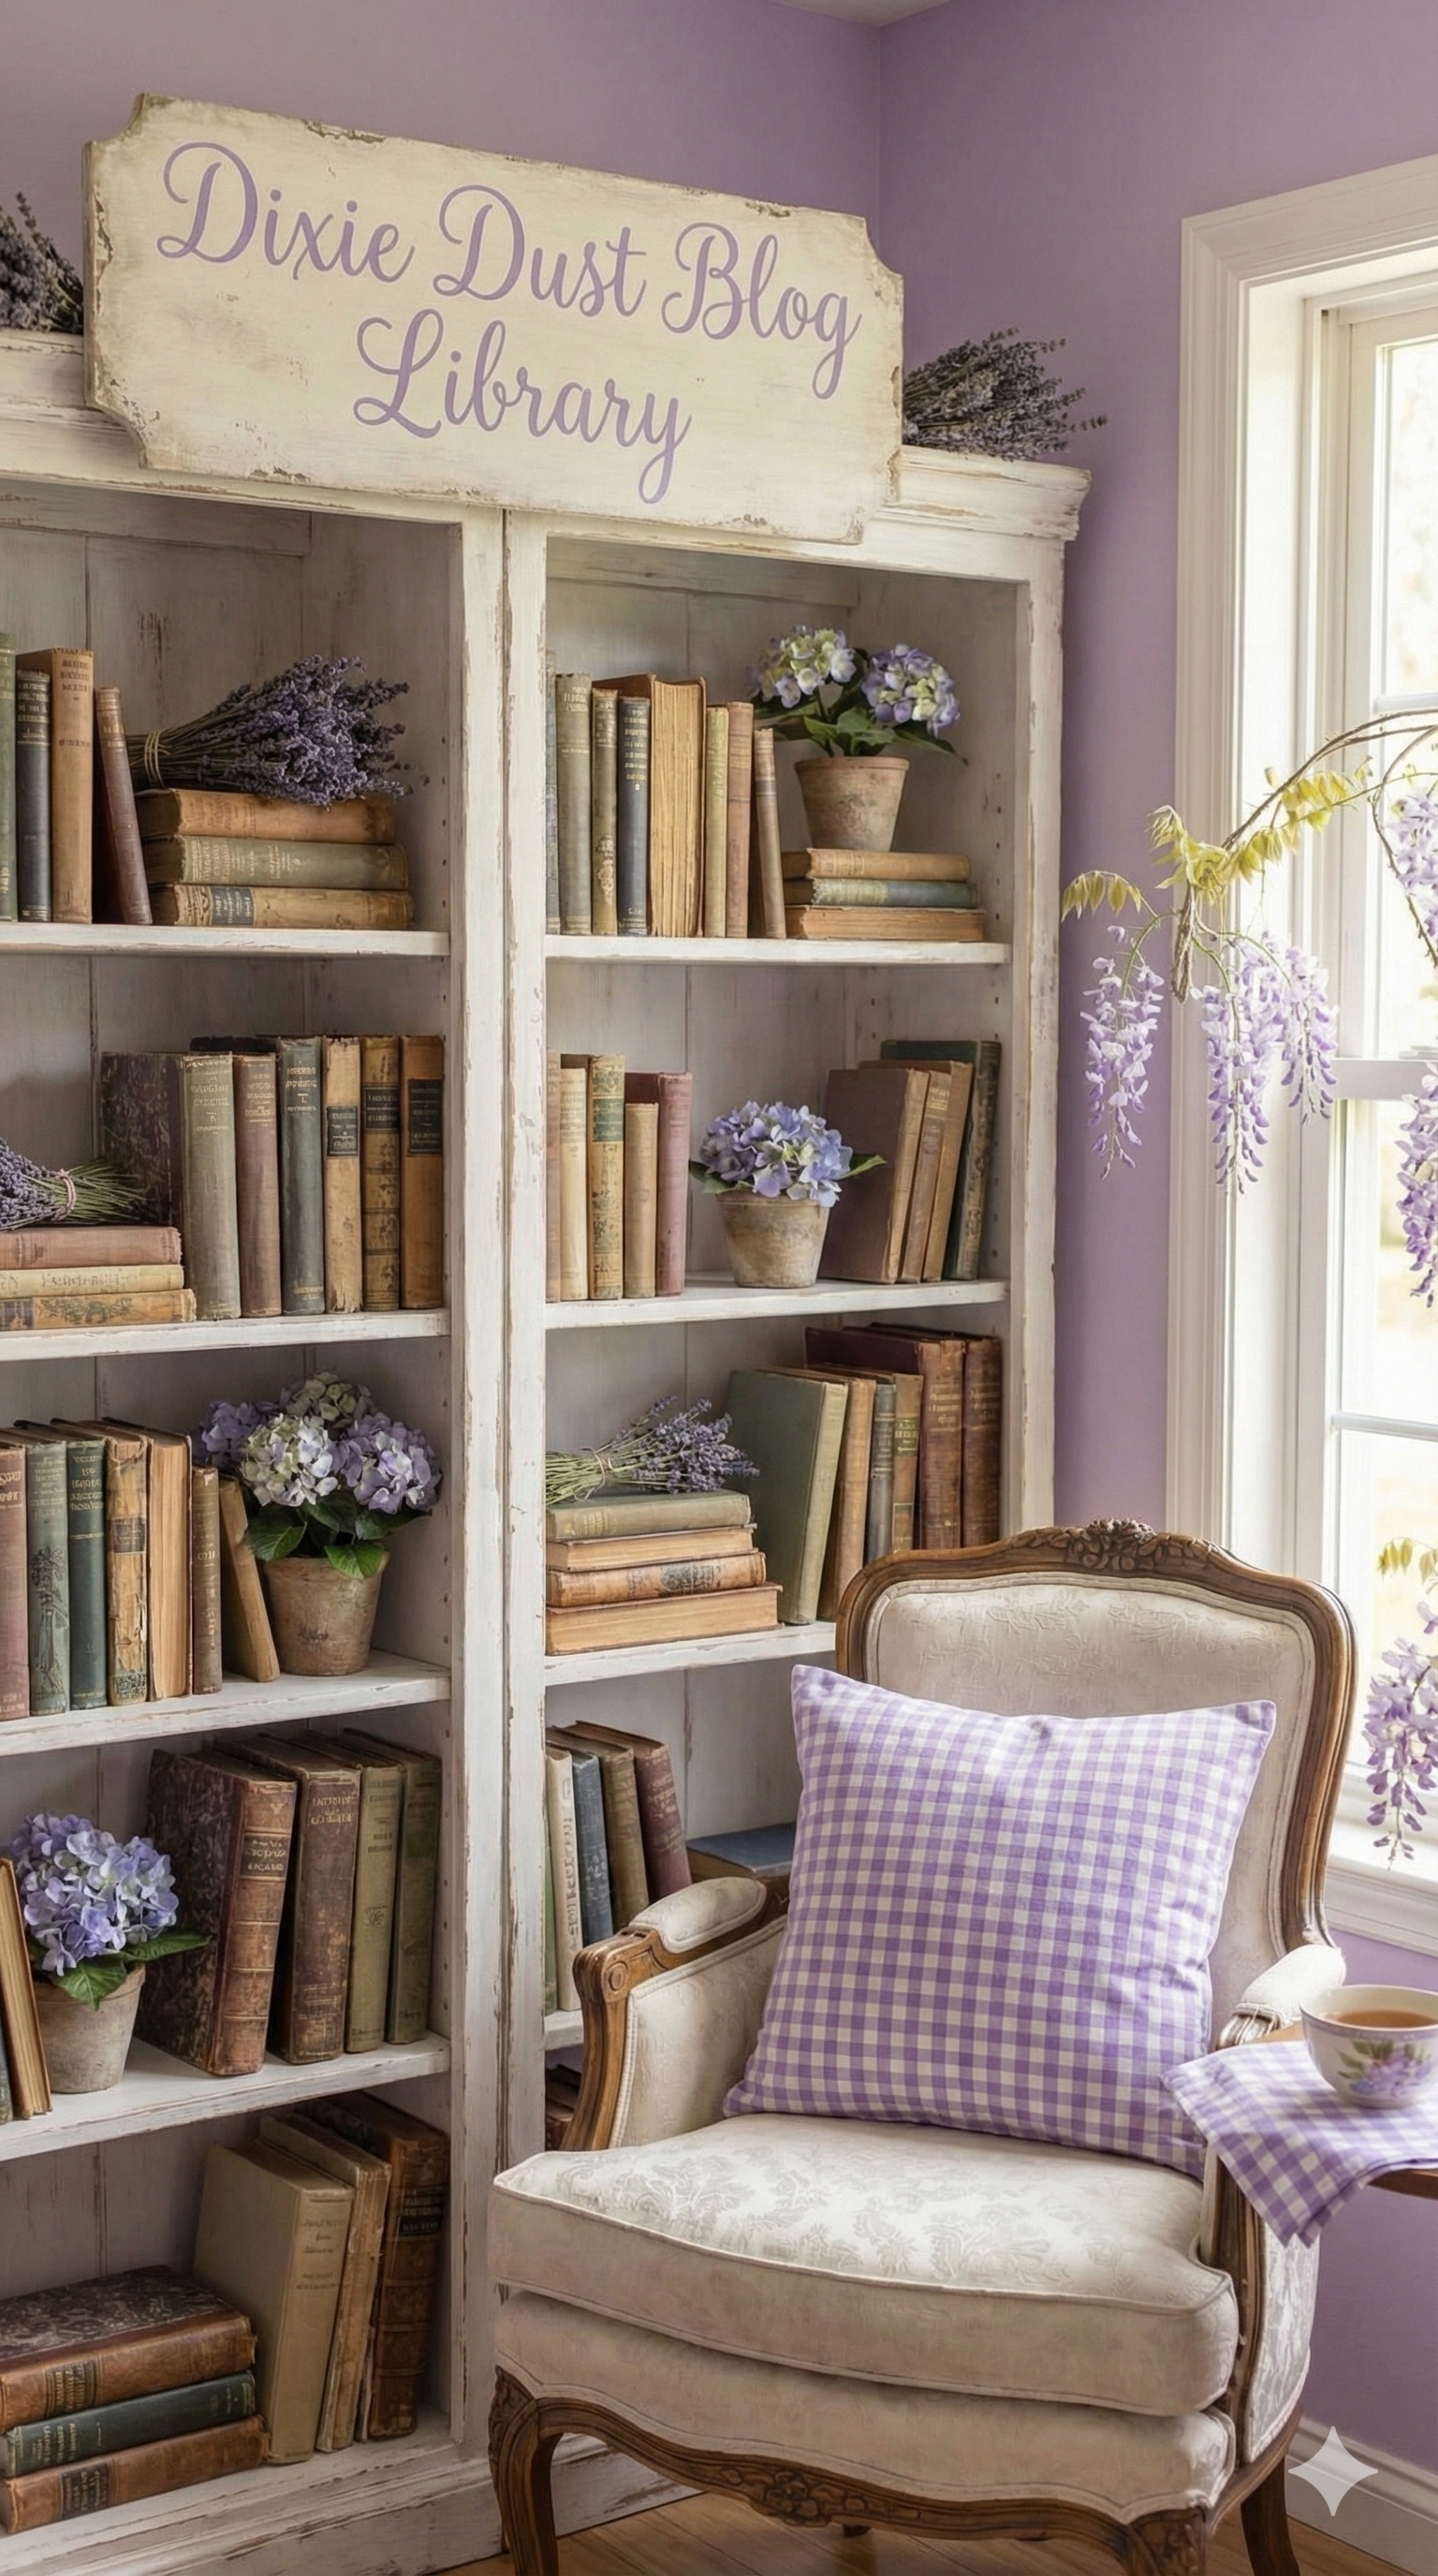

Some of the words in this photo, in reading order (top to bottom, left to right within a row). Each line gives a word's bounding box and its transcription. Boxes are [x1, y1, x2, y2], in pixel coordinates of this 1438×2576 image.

[156, 141, 416, 283] Dixie
[433, 184, 647, 318] Dust
[661, 222, 862, 401] Blog
[353, 308, 692, 505] Library
